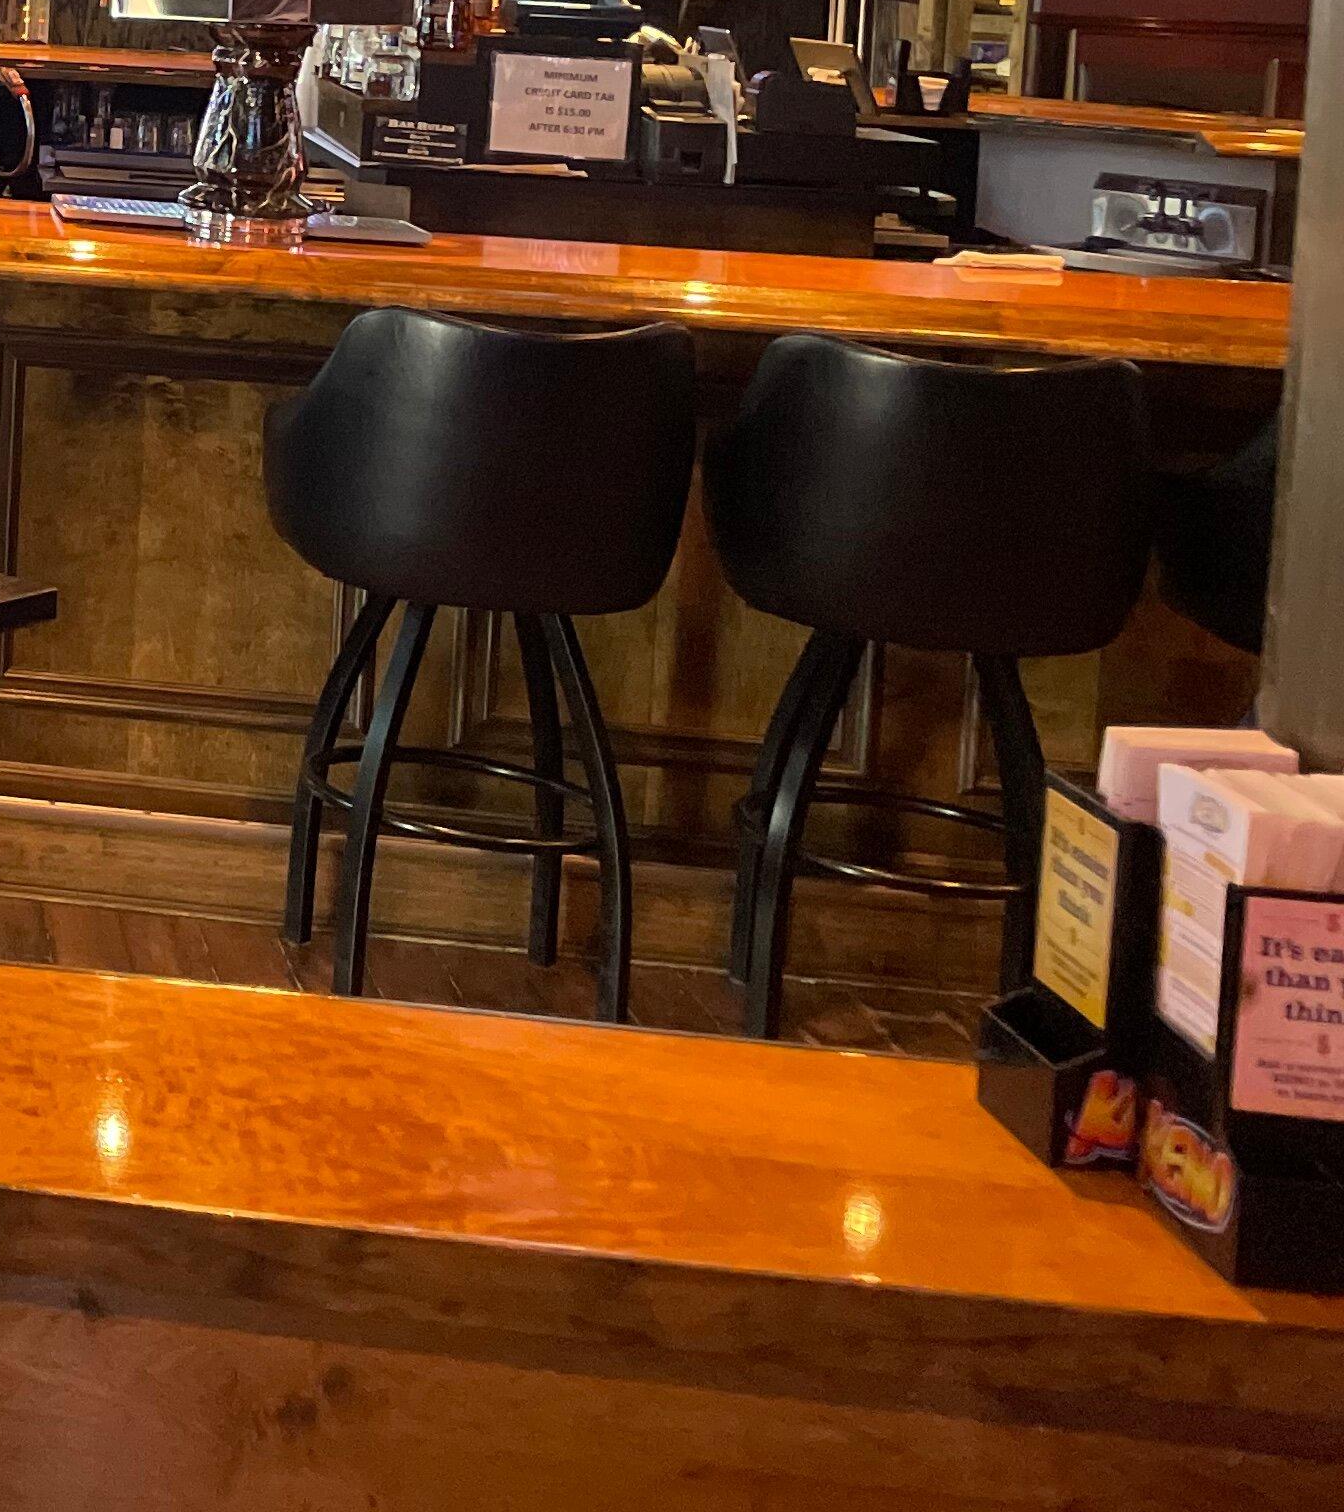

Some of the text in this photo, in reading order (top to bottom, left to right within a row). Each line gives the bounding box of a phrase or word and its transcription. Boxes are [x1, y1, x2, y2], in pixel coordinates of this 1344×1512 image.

[544, 71, 598, 83] MINIMUM
[563, 90, 592, 100] CARD
[529, 123, 605, 136] AFTER 6:30 PM
[1261, 936, 1303, 961] It's
[1266, 968, 1330, 991] than
